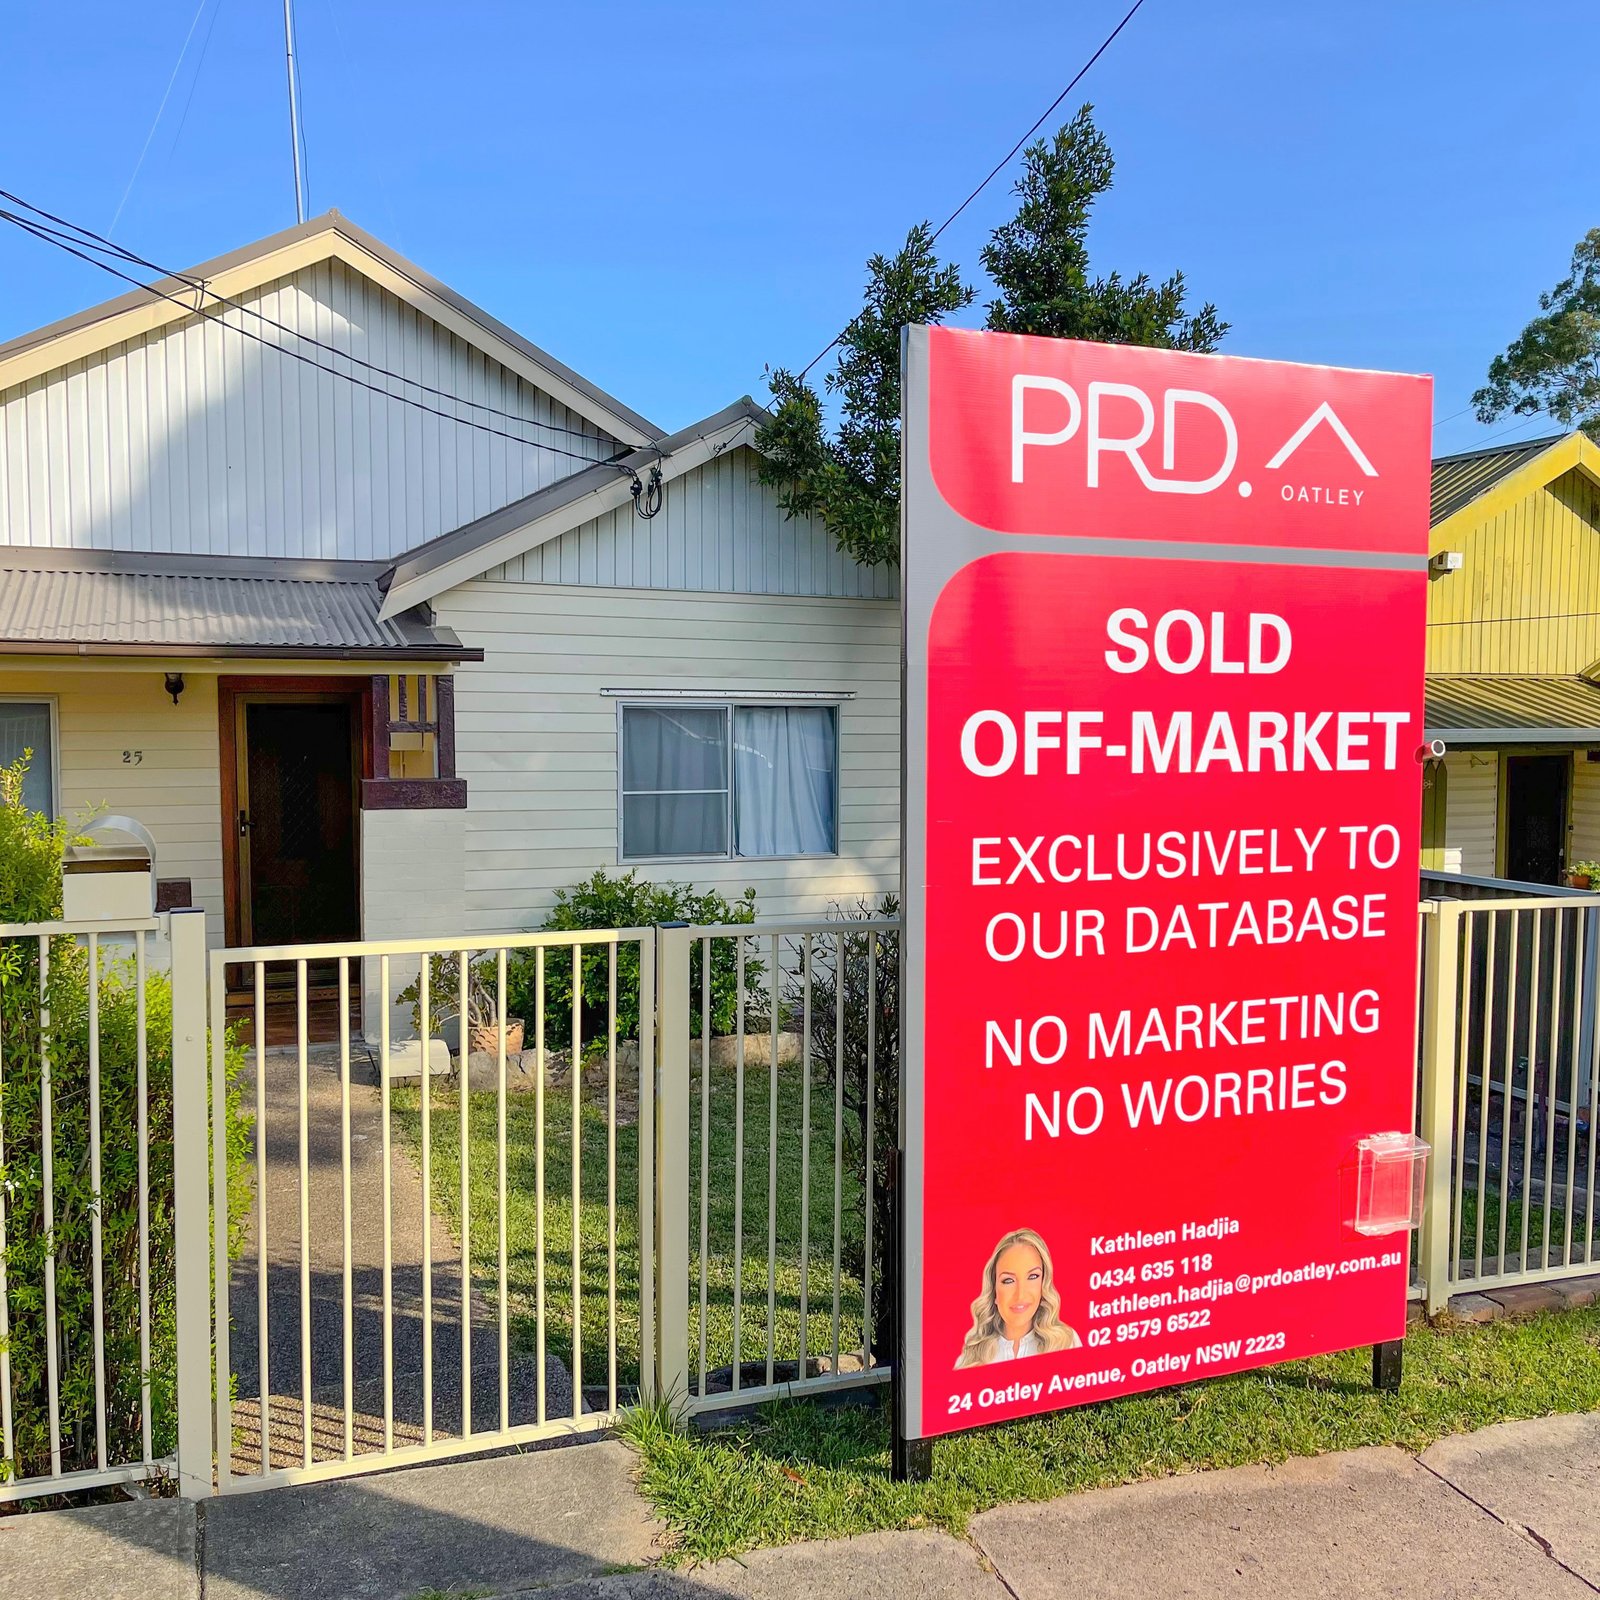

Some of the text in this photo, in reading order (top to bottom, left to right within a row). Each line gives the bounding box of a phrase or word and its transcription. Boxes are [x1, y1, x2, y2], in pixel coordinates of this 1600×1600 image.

[1280, 484, 1366, 507] OATLEY
[1105, 608, 1291, 674] SOLD
[122, 750, 143, 766] 25
[961, 710, 1410, 777] OFF-MARKET
[973, 824, 1400, 885] EXCLUSIVELY TO
[986, 894, 1386, 961] OUR DATABASE
[986, 990, 1379, 1068] NO MARKETING
[1026, 1061, 1346, 1140] NO WORRIES
[1091, 1217, 1239, 1255] Kathleen Hadjia
[1090, 1254, 1212, 1289] 0434 635 118
[1088, 1309, 1210, 1347] 02 9579 6522
[948, 1332, 1285, 1414] 24 Oatley Avenue, Oatley NSW 2223
